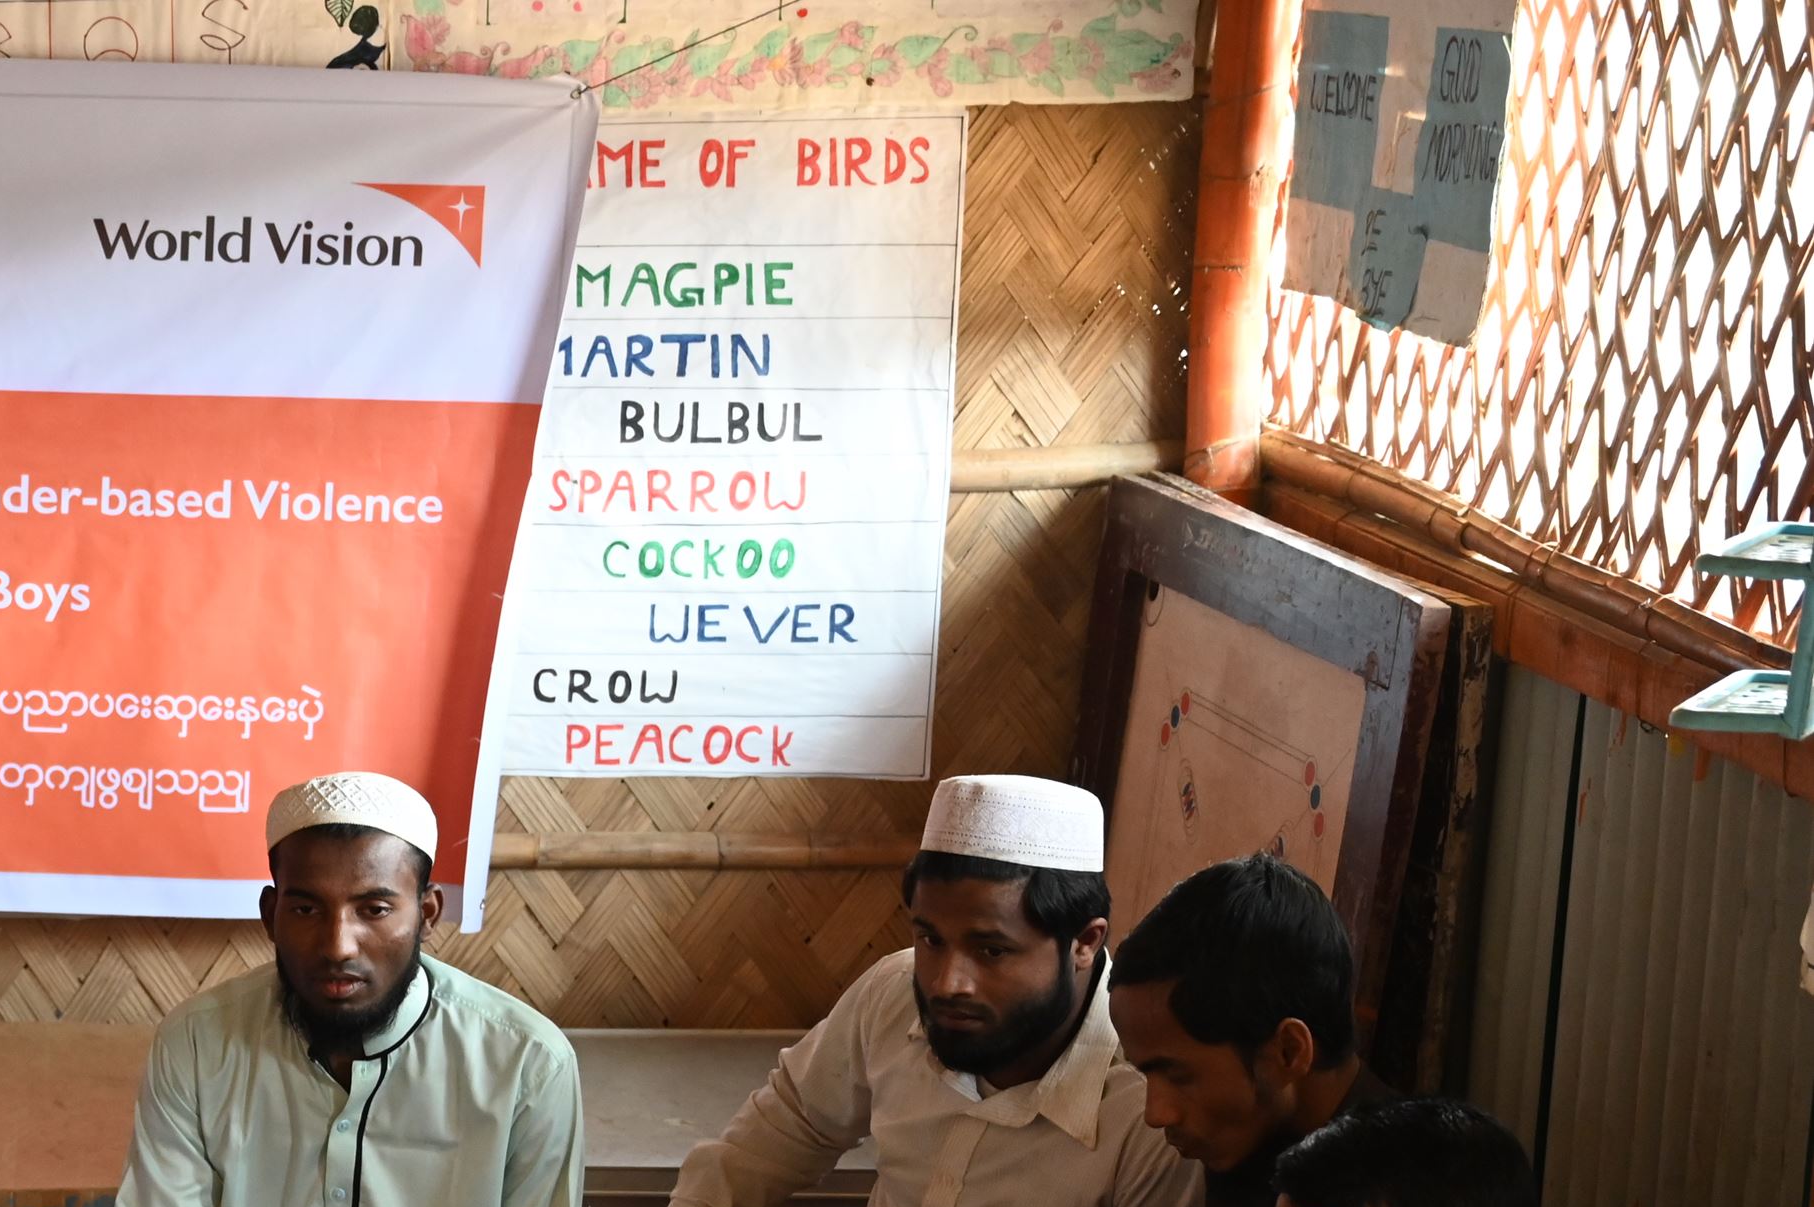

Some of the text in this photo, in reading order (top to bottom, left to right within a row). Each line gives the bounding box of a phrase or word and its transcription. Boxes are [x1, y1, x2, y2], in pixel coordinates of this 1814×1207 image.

[698, 139, 756, 187] OF
[797, 136, 931, 187] BIRDS
[93, 215, 423, 268] World Vision
[576, 261, 794, 308] MAGPIE
[620, 400, 823, 444] BULBUL
[243, 479, 443, 523] Violence
[548, 469, 807, 514] SPARROW
[602, 539, 796, 580] COCKOO
[649, 603, 859, 644] WEVER
[532, 668, 678, 705] CROW
[565, 723, 794, 767] PEACOCK
